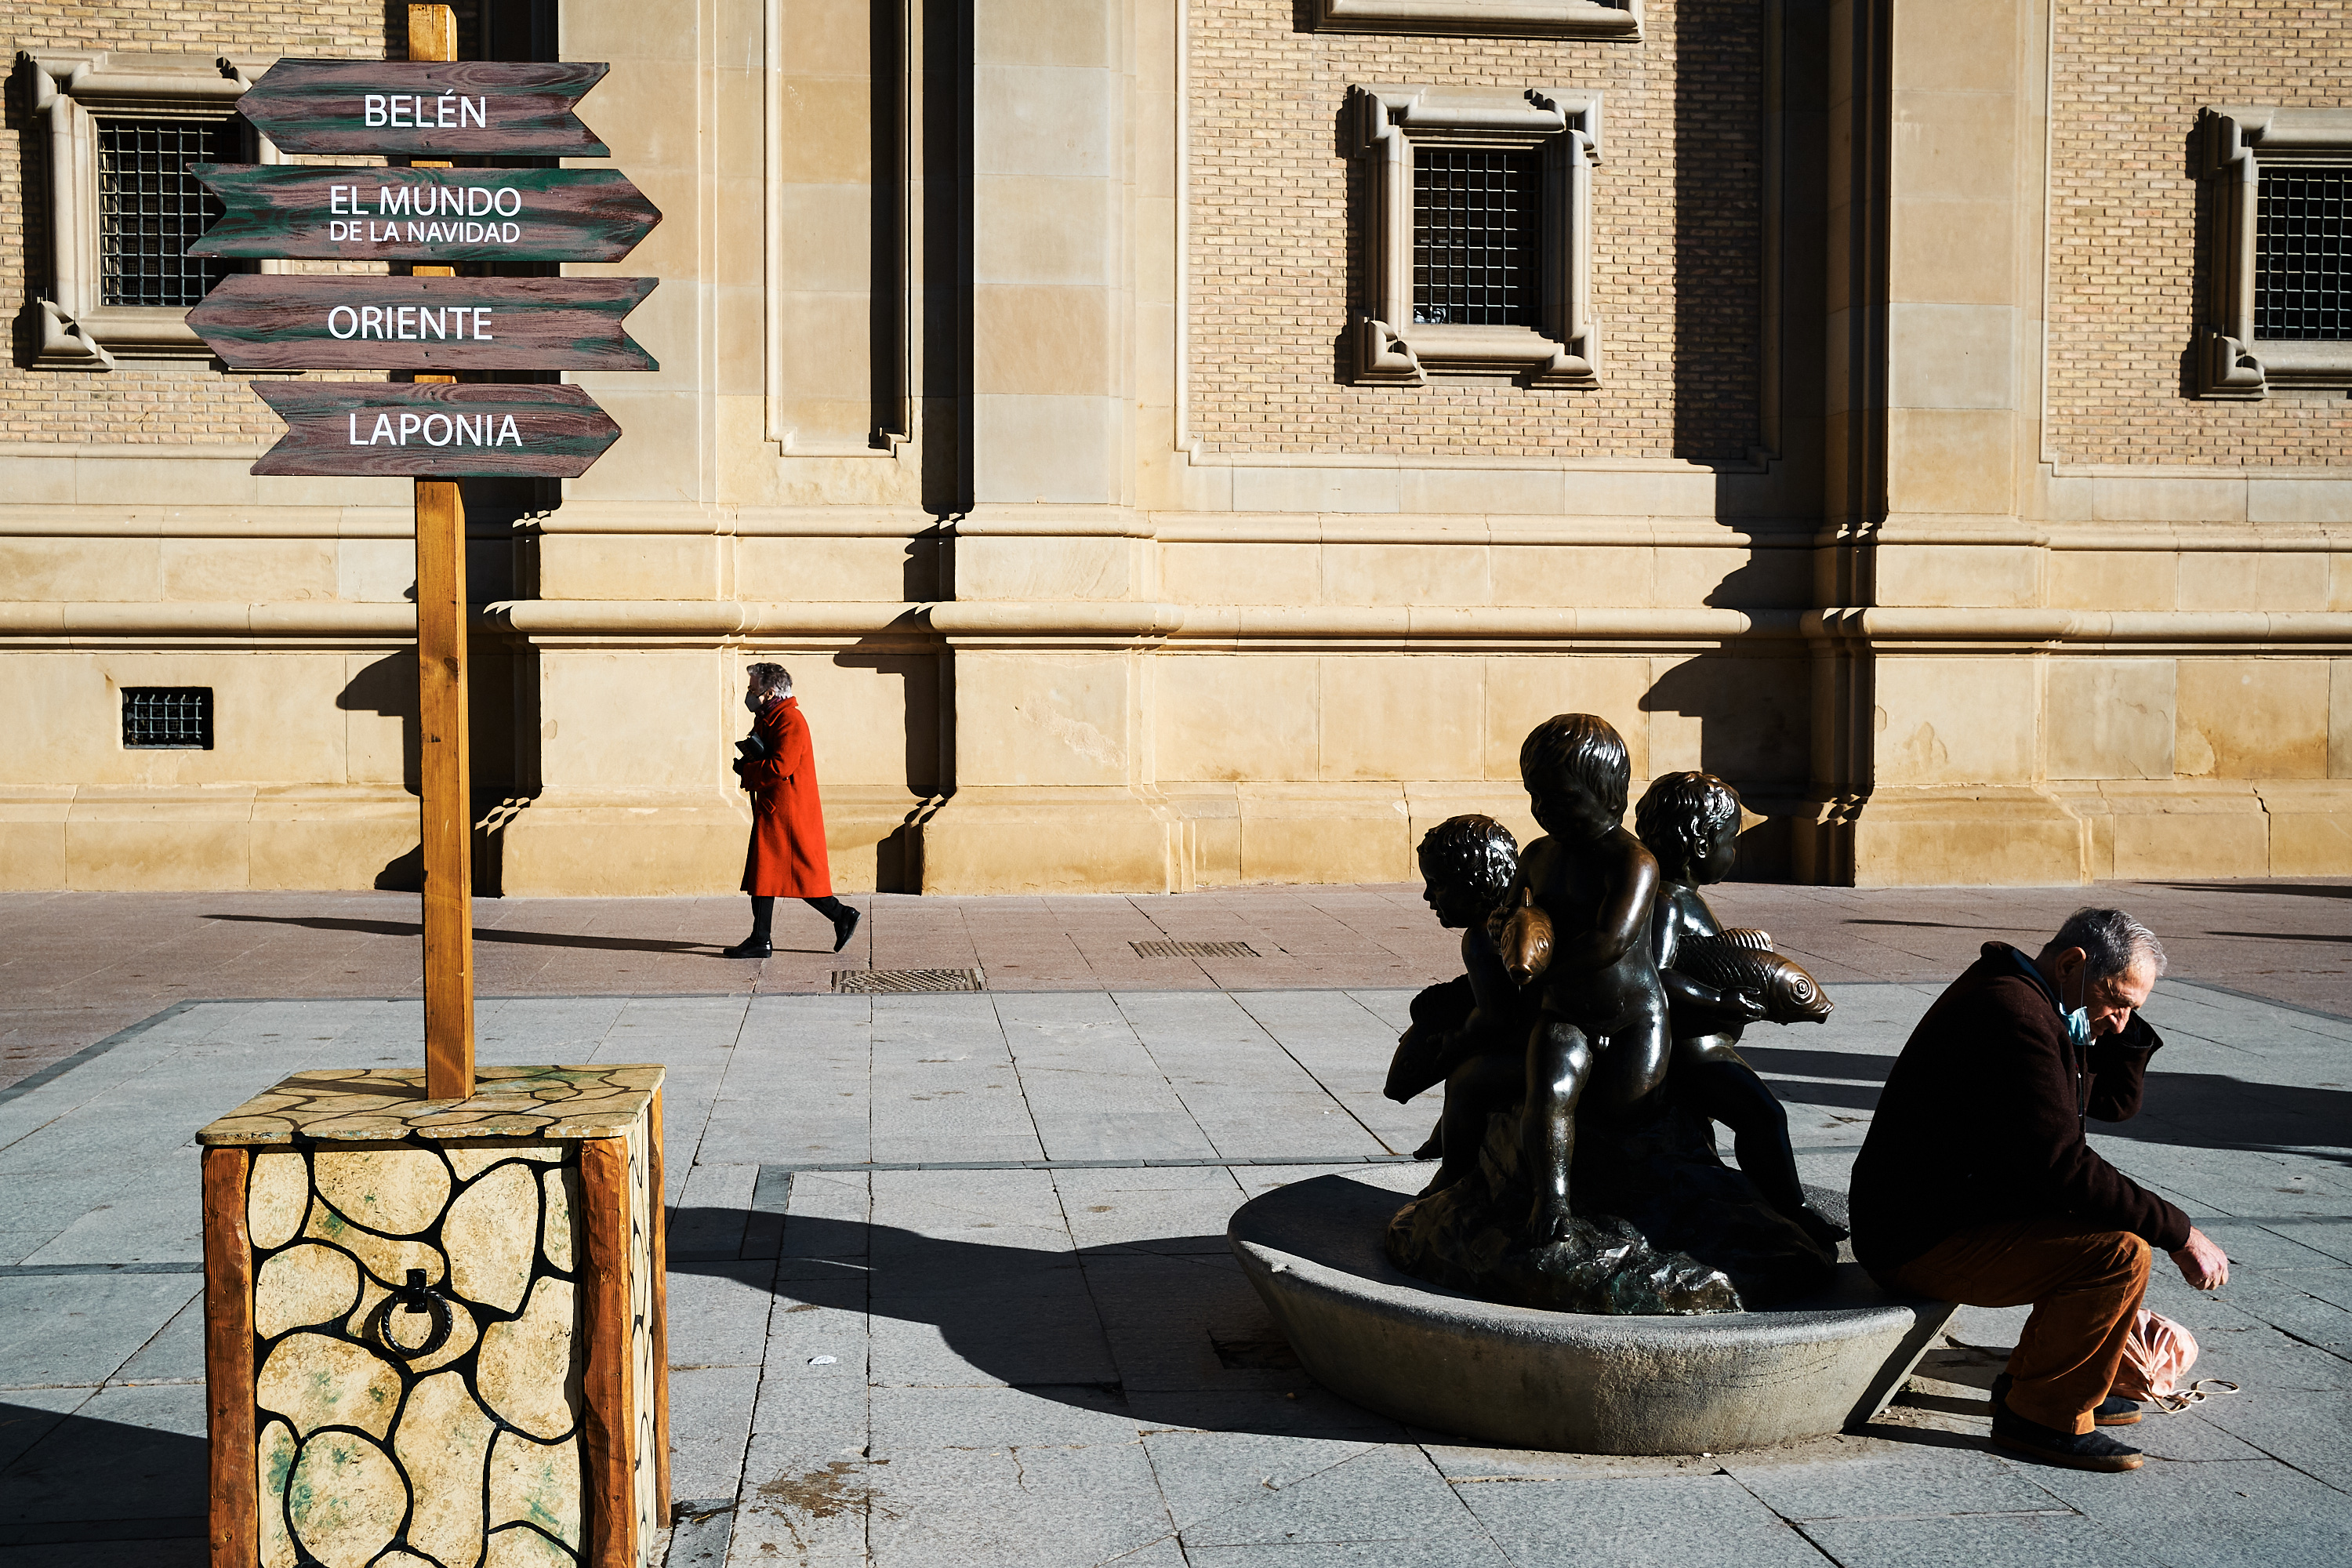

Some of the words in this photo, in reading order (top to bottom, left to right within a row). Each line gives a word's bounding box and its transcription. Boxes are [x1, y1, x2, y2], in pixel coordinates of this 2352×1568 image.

[364, 88, 487, 129] BELÉN
[329, 185, 369, 215] EL
[379, 186, 522, 217] MUNDO
[329, 220, 363, 241] DE
[369, 220, 401, 242] LA
[406, 221, 521, 244] NAVIDAD
[327, 305, 494, 340] ORIENTE
[349, 412, 523, 447] LAPONIA
